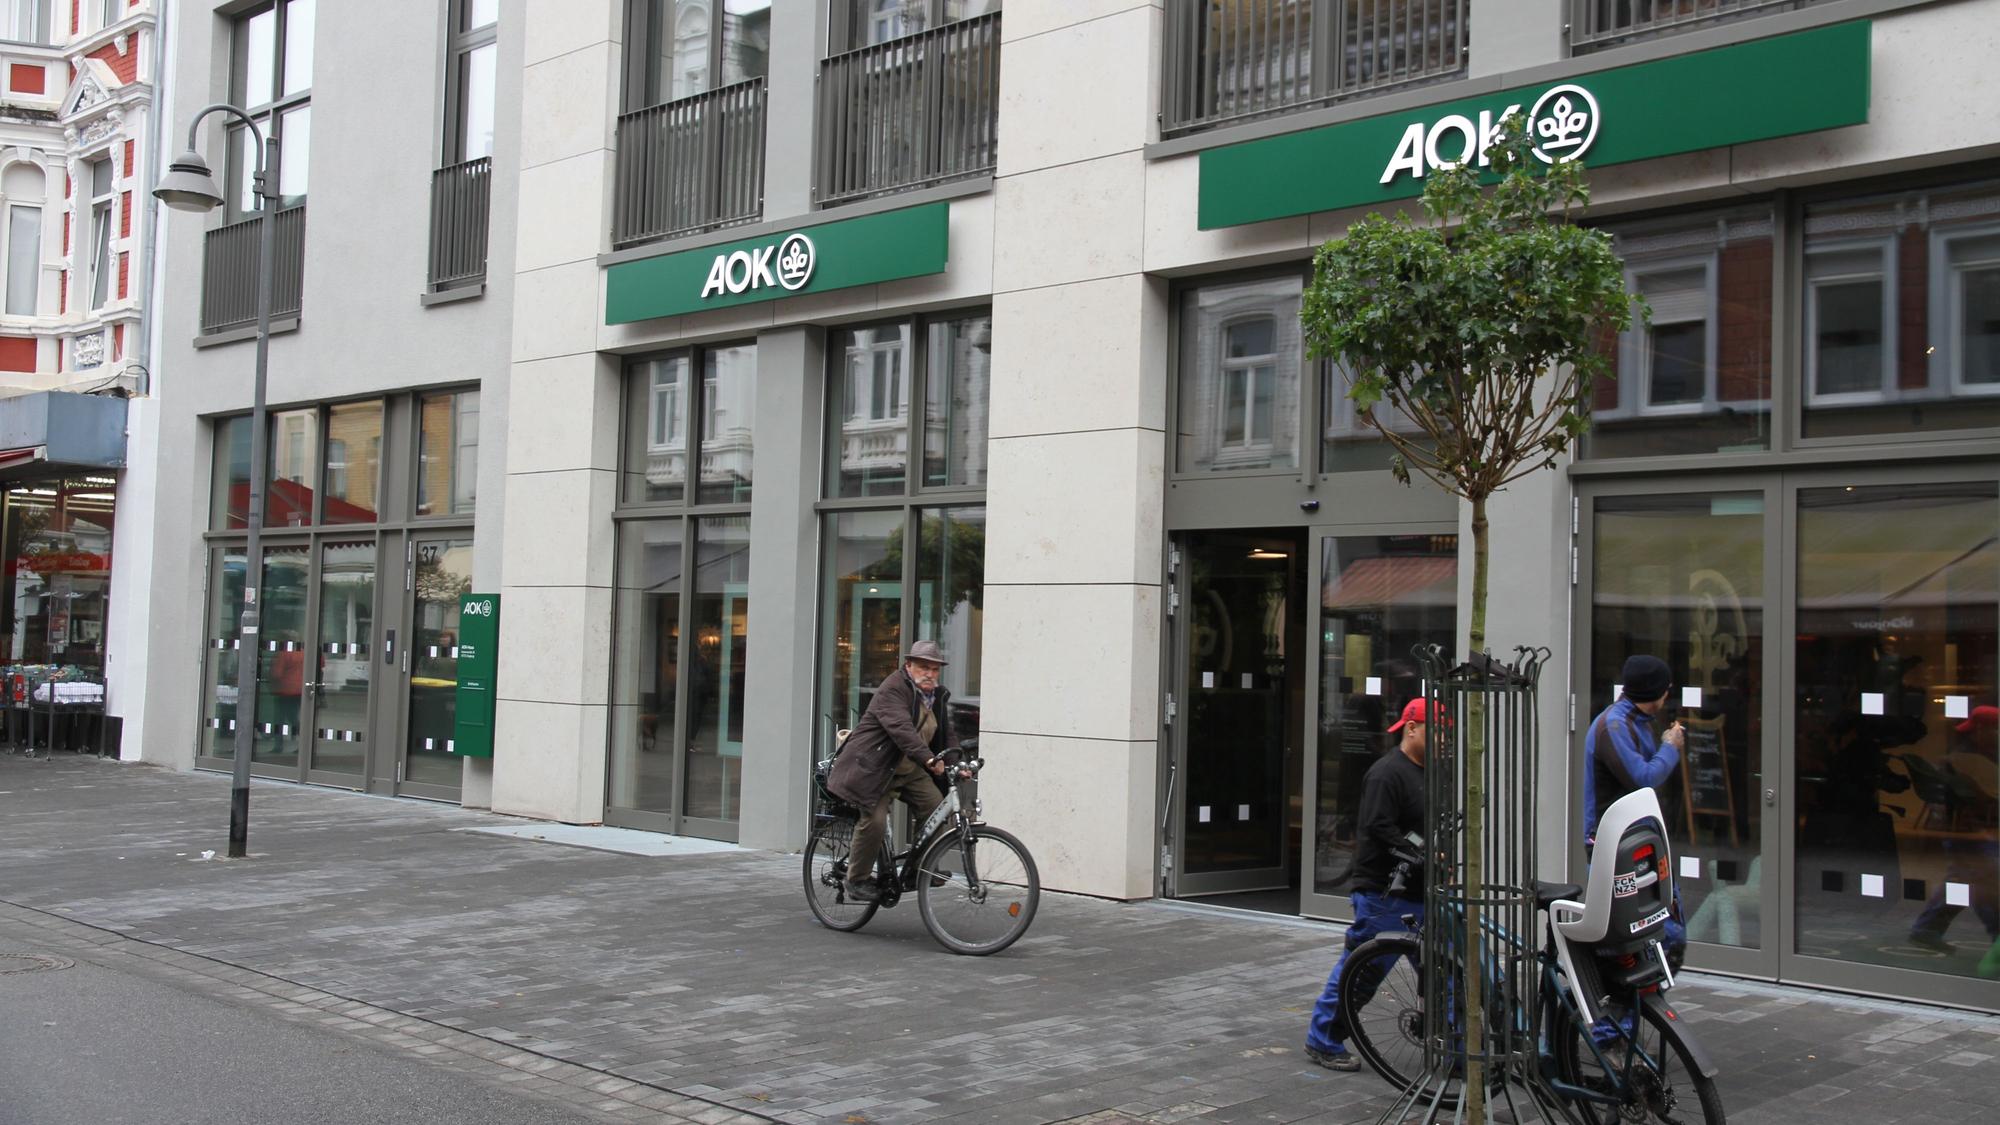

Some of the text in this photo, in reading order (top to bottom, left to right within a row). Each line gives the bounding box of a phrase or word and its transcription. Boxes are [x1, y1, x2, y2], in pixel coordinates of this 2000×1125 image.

[1379, 104, 1521, 184] AOK
[701, 245, 777, 298] AOK
[422, 545, 438, 566] 37
[463, 602, 482, 614] AOK
[1615, 877, 1635, 886] FCK
[1616, 883, 1636, 893] NZS
[1647, 910, 1667, 924] BONN
